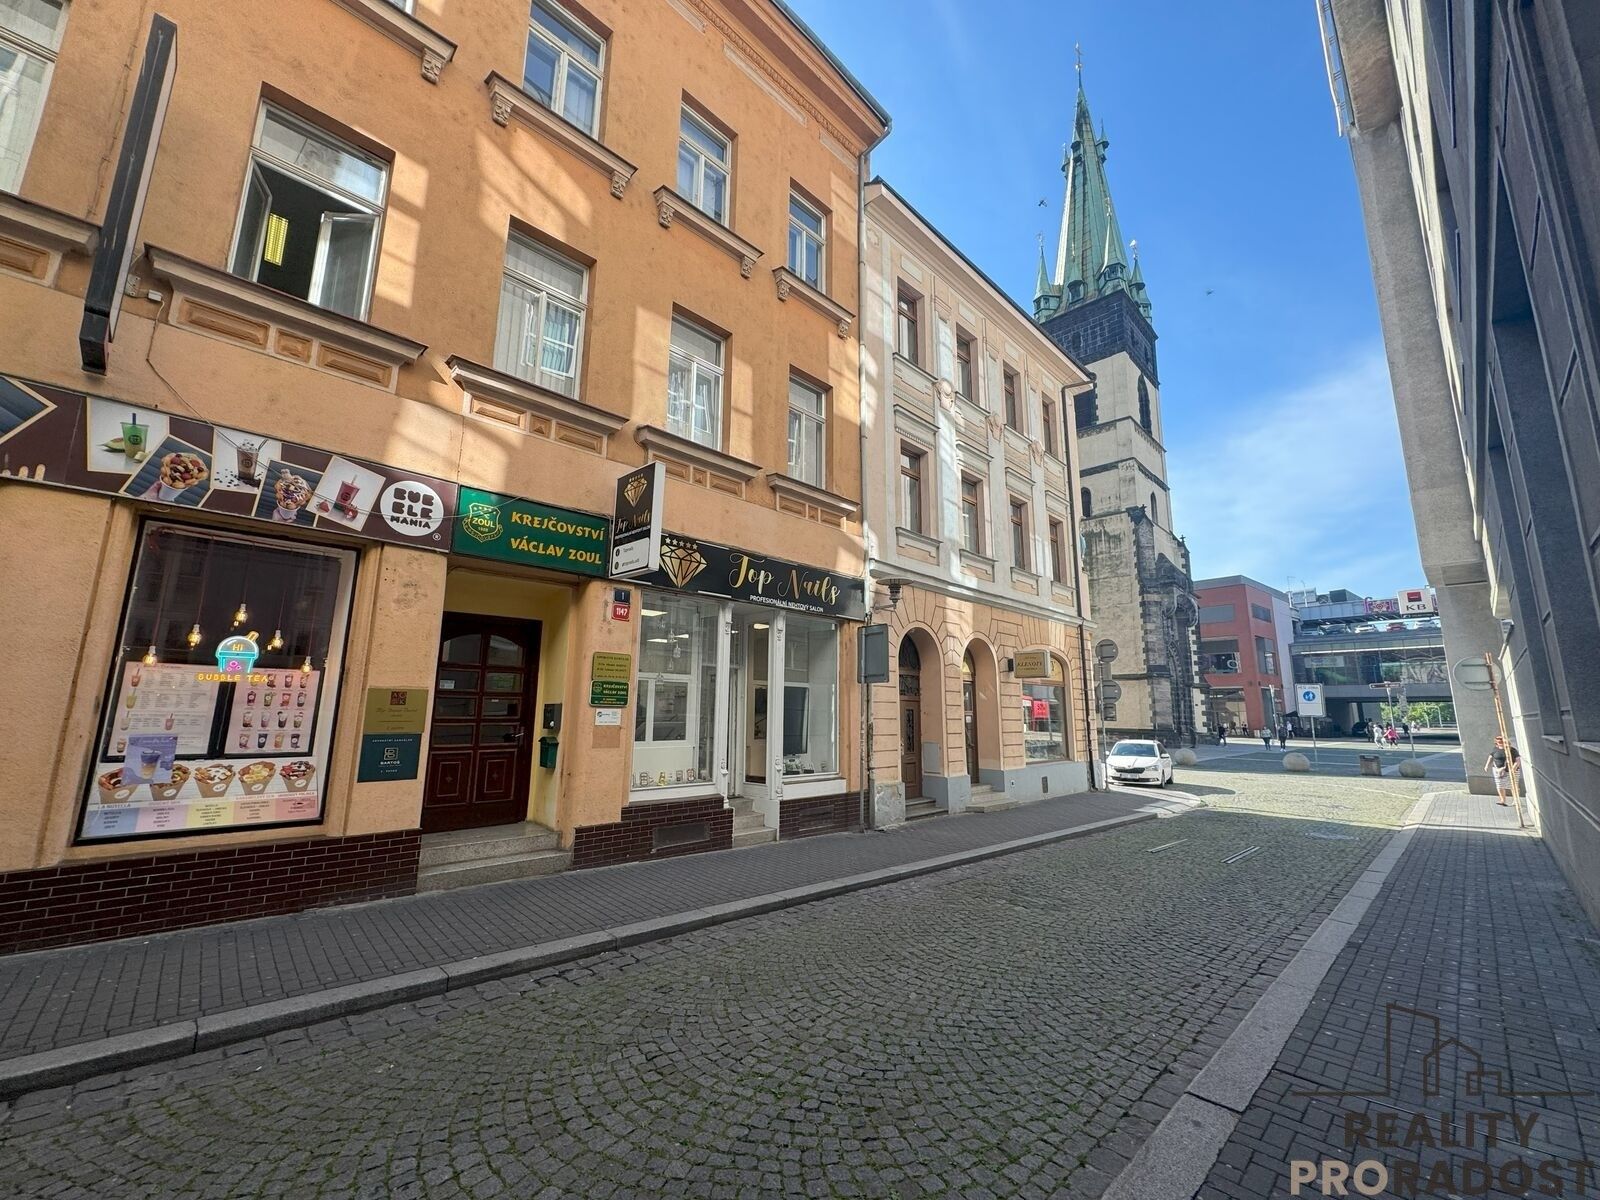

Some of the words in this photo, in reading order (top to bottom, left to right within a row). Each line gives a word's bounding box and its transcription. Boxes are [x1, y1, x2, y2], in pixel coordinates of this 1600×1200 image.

[390, 515, 431, 529] MANIA
[472, 518, 495, 528] ZOUL
[511, 511, 605, 541] KREJČOVSTVÍ
[510, 535, 565, 557] VÁCLAV
[568, 549, 602, 564] ZOUL
[729, 553, 774, 595] Top
[777, 569, 840, 606] Nails
[749, 594, 788, 607] PROFESIONÁLNÍ
[809, 604, 824, 613] SALON
[1406, 603, 1427, 611] KB
[616, 607, 628, 616] 1147
[198, 673, 241, 682] BUBBLE
[247, 674, 269, 683] TEA
